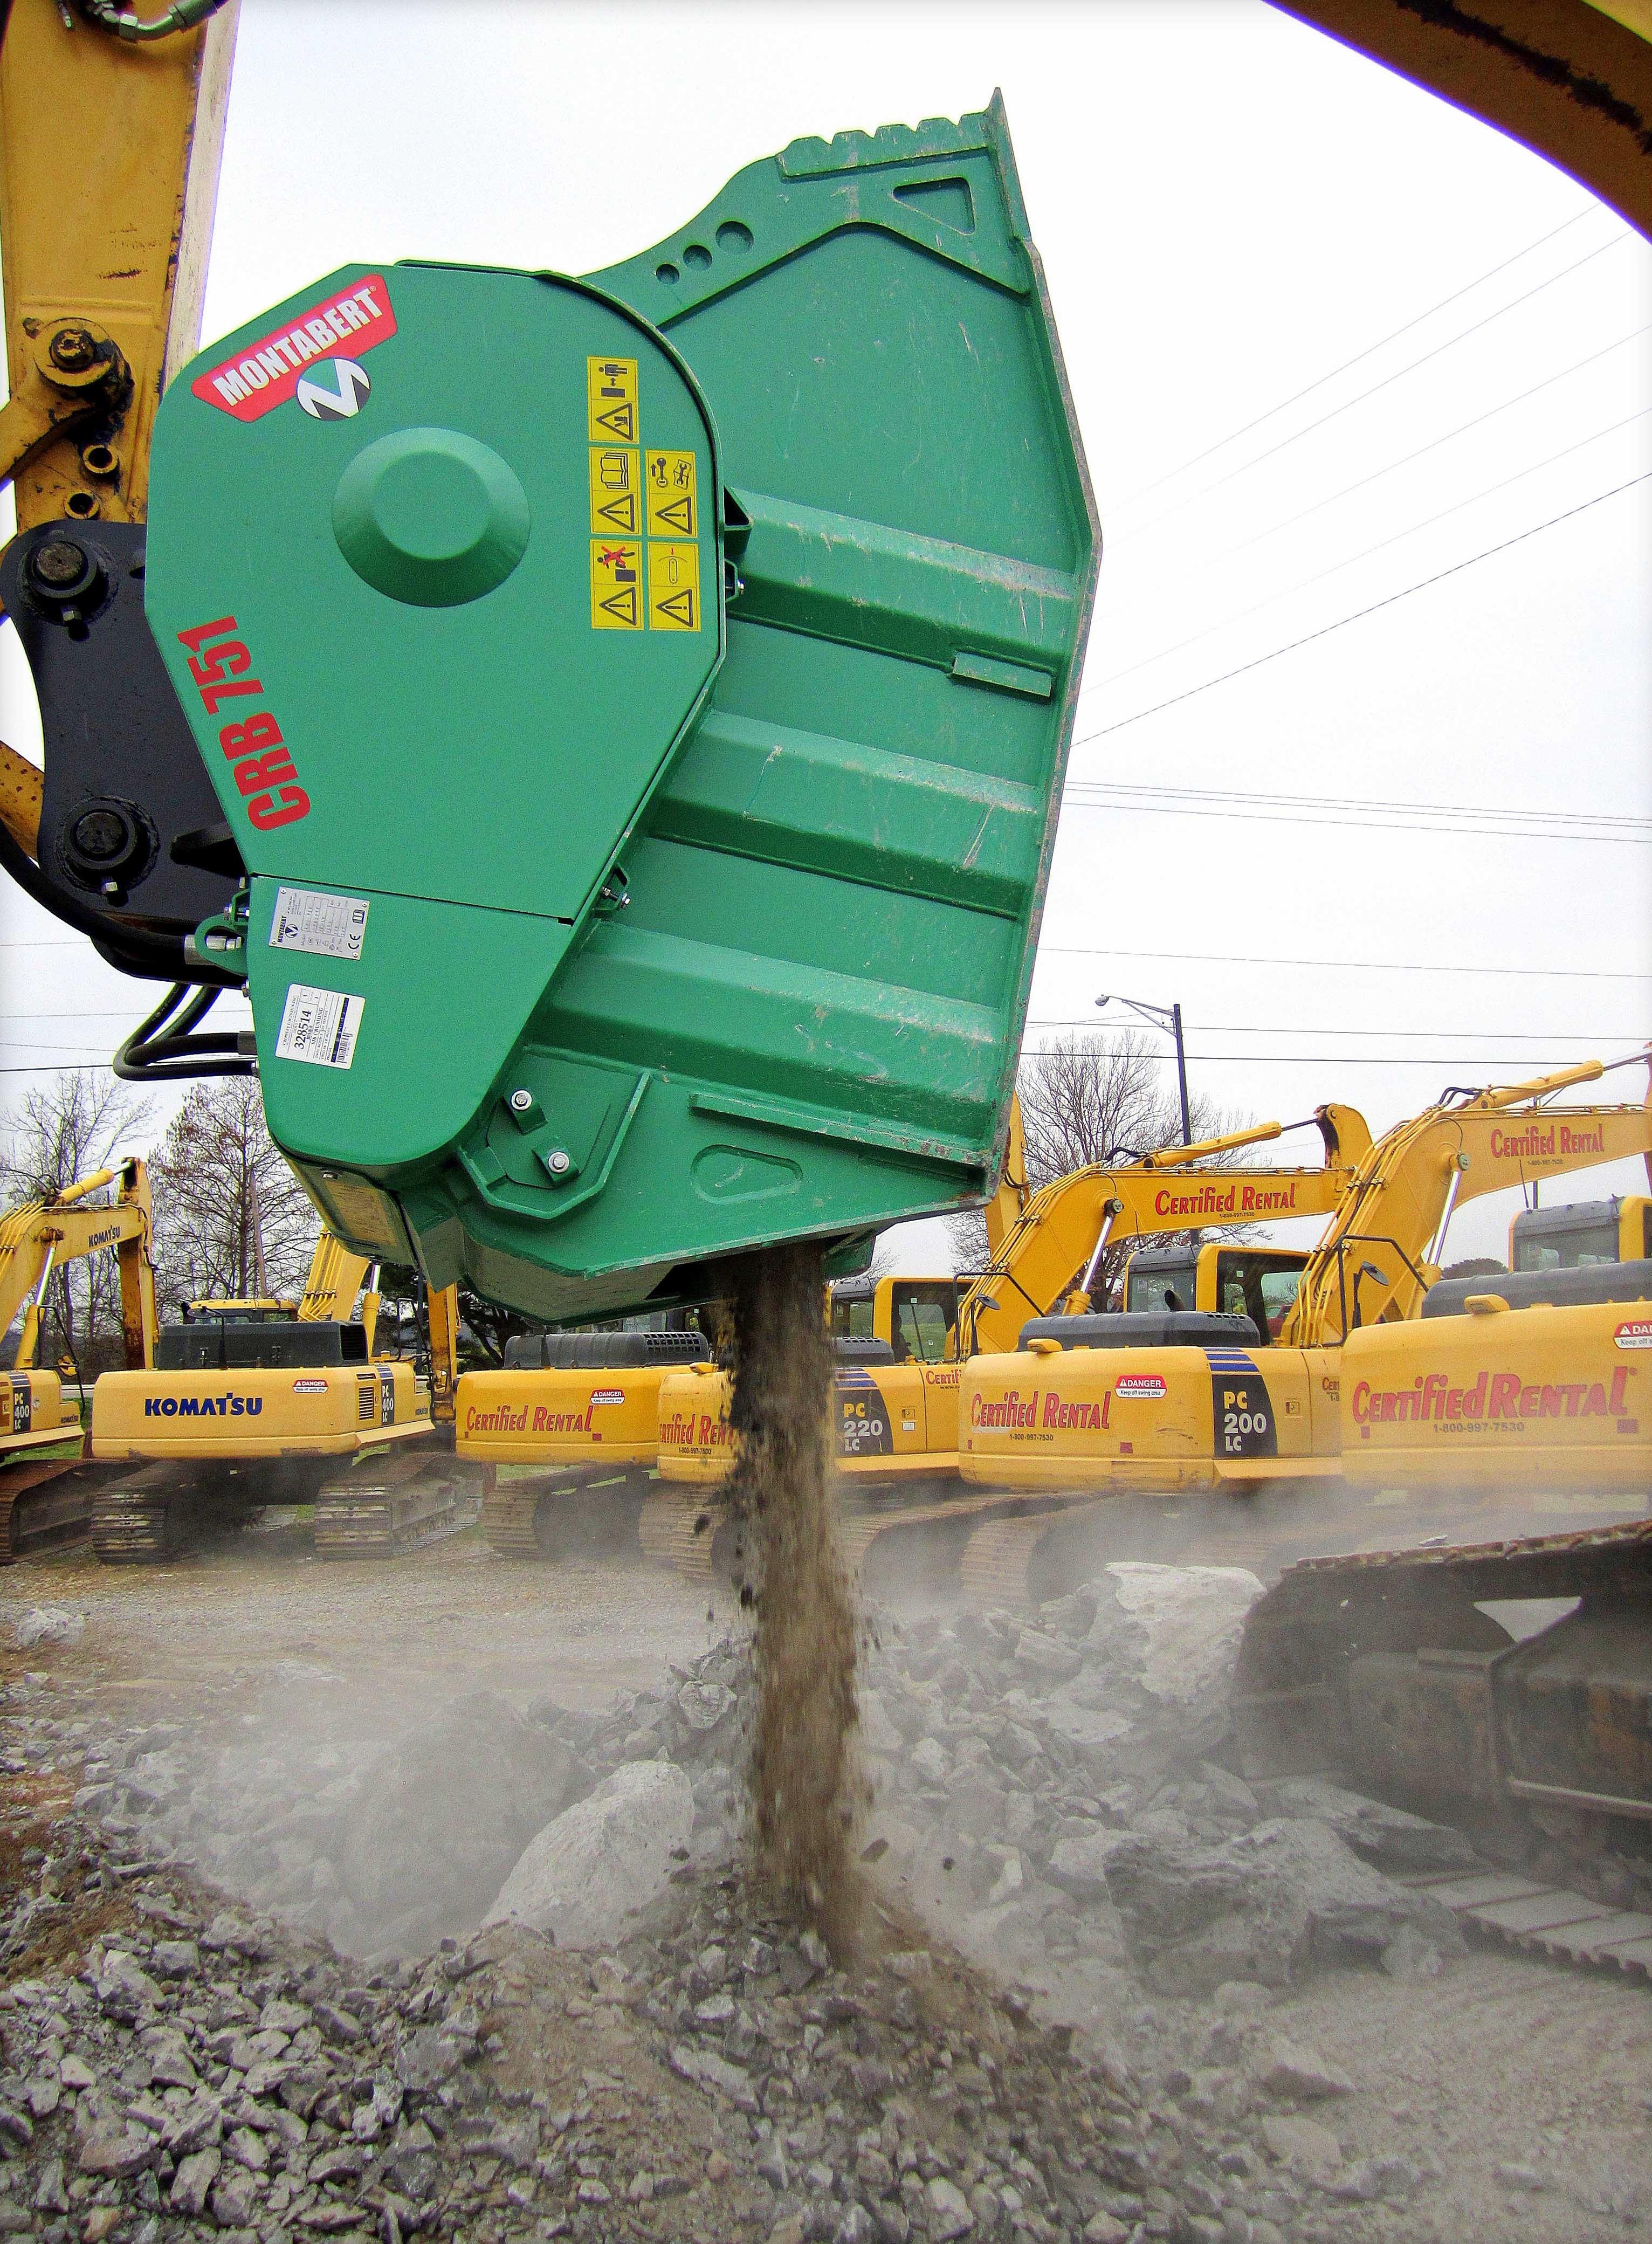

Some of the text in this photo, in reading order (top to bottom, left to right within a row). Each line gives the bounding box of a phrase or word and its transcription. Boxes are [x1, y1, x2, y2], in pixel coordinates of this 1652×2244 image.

[212, 288, 383, 406] MONTABERT
[177, 615, 311, 830] CRB 751
[293, 1009, 312, 1050] 328514
[382, 1385, 389, 1397] PC
[1127, 1379, 1161, 1387] DANGER
[14, 1393, 24, 1405] PC
[144, 1391, 263, 1416] KOMATSU
[382, 1399, 394, 1412] 400
[1223, 1391, 1248, 1409] PC
[14, 1405, 30, 1419] 400
[843, 1403, 866, 1418] PC
[844, 1420, 883, 1438] 220
[1224, 1413, 1266, 1434] 200
[1433, 1422, 1525, 1433] 1-800-997-7530
[845, 1438, 860, 1451] LC
[1226, 1435, 1242, 1452] LC
